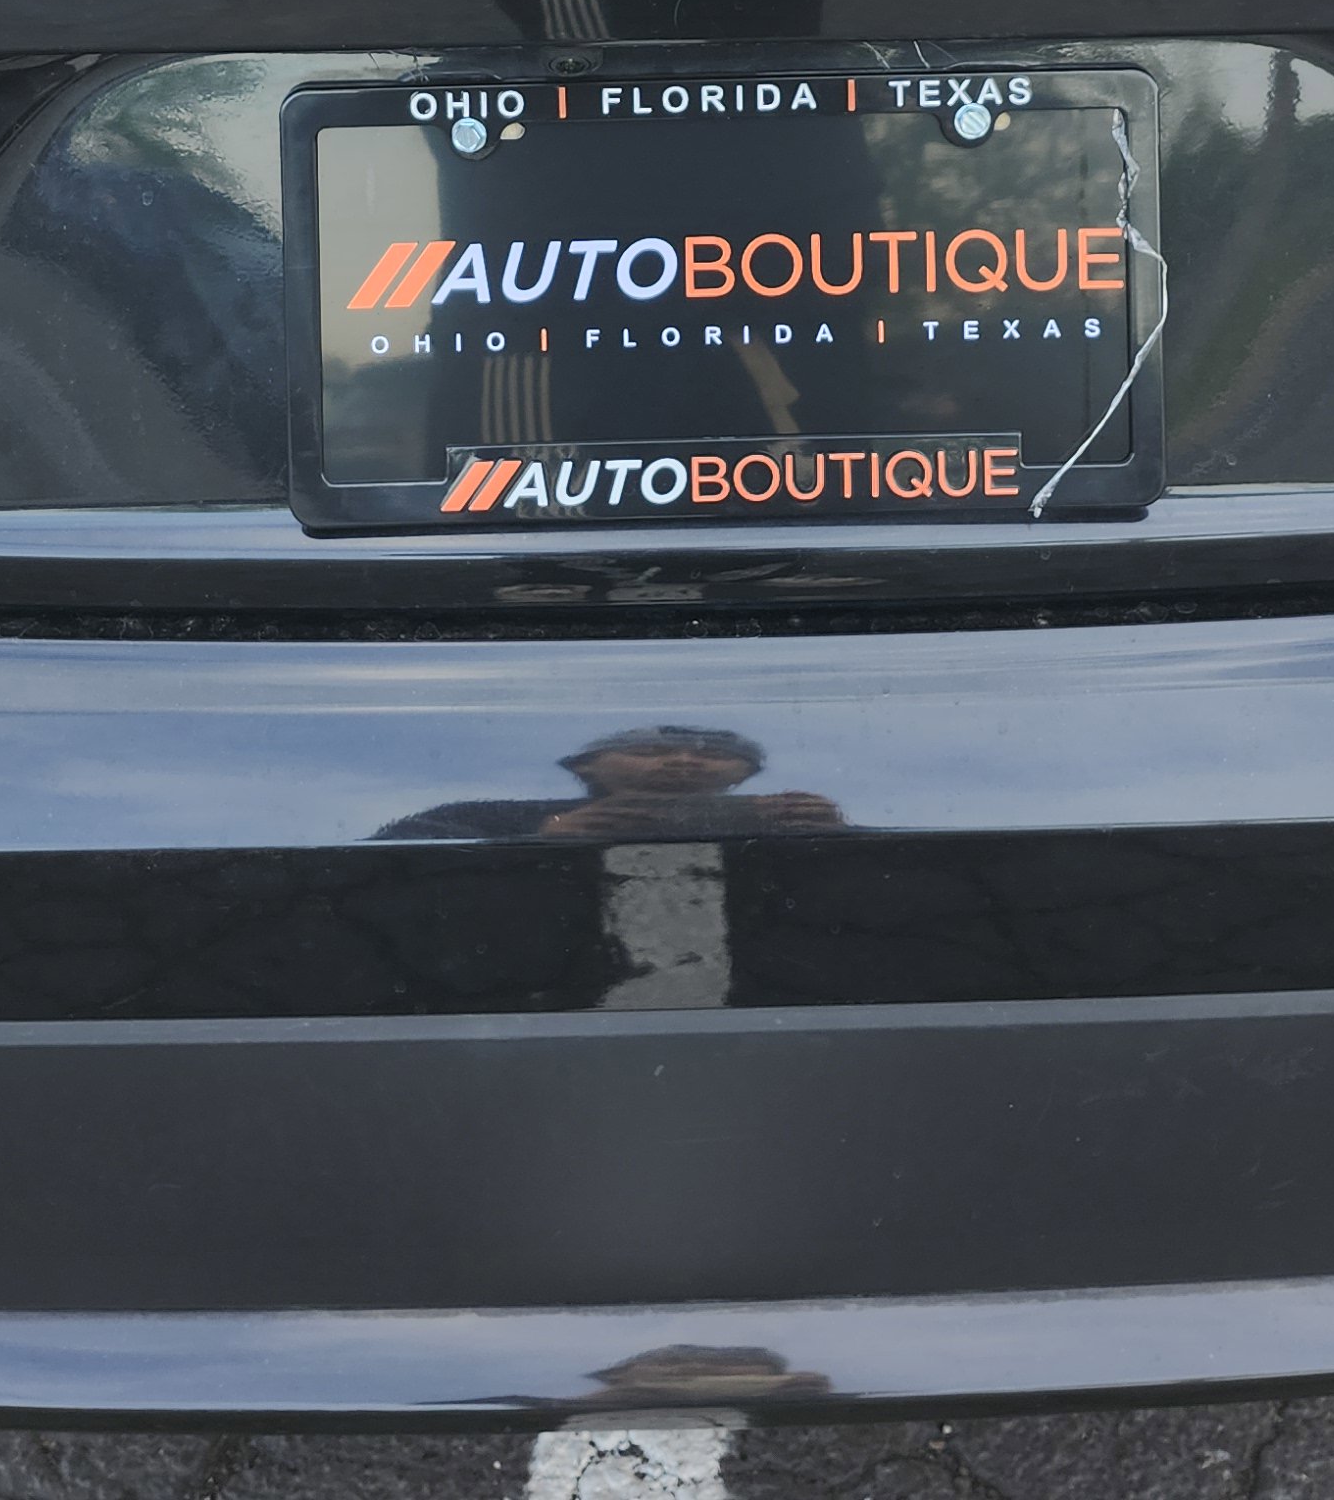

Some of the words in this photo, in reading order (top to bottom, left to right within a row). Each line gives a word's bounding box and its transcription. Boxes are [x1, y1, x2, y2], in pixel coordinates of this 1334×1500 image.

[409, 88, 526, 121] OHIO
[601, 83, 818, 116] FLORIDA
[888, 77, 1033, 109] TEXAS
[370, 330, 506, 355] OHIO
[584, 323, 835, 349] FLORIDA
[923, 317, 1102, 342] TEXAS
